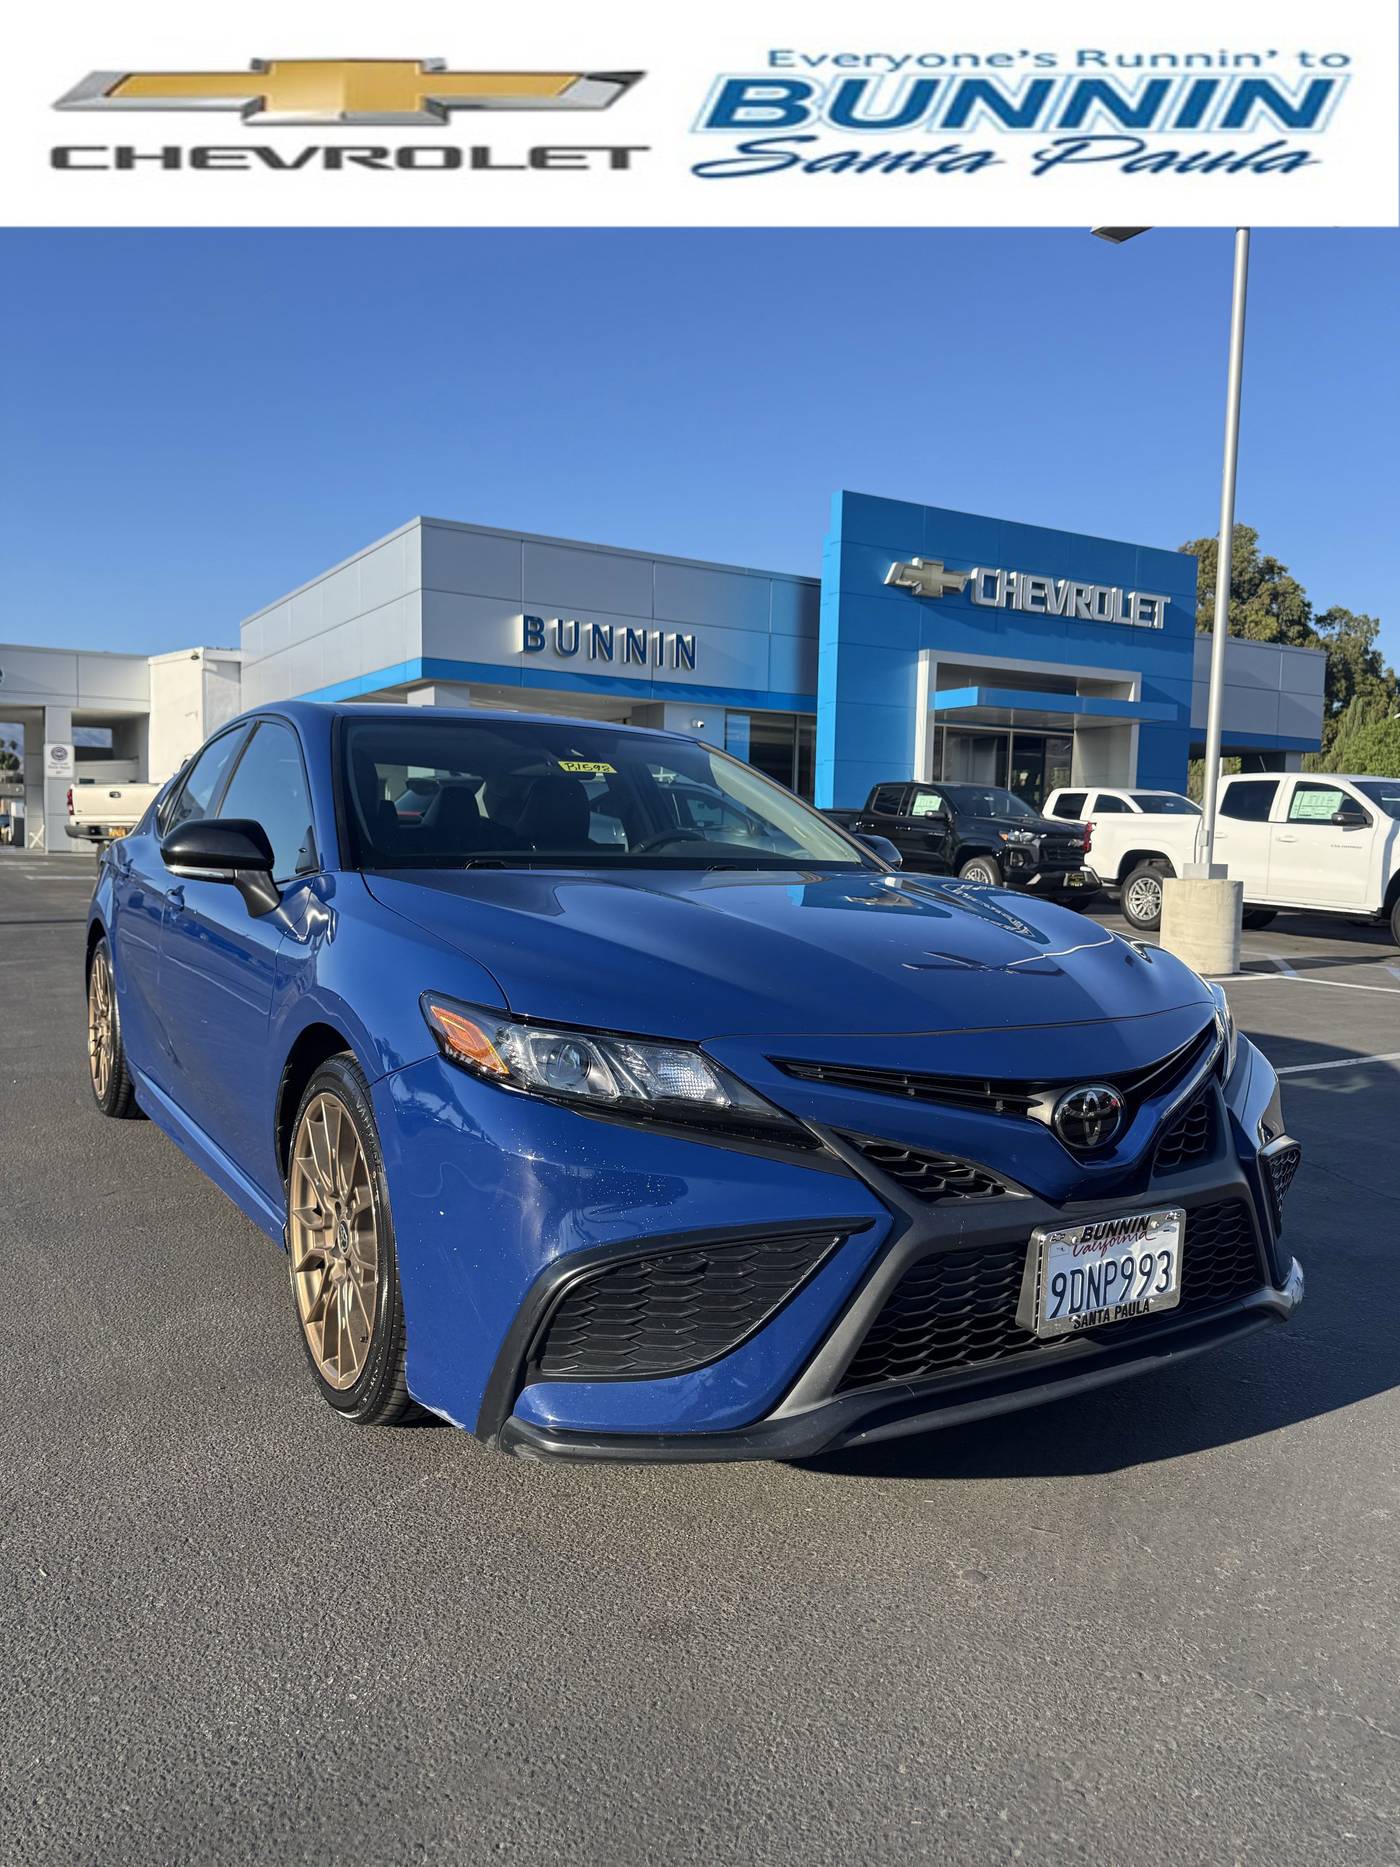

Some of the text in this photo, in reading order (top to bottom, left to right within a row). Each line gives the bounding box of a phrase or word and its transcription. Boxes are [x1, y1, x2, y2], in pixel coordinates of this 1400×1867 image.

[970, 567, 1171, 629] CHEVROLET
[515, 614, 698, 671] BUNNIN
[1072, 1231, 1156, 1257] California
[1080, 1215, 1151, 1243] BUNNIN
[1050, 1250, 1171, 1319] 9DNP993
[1072, 1300, 1150, 1329] SANTA PAULA
